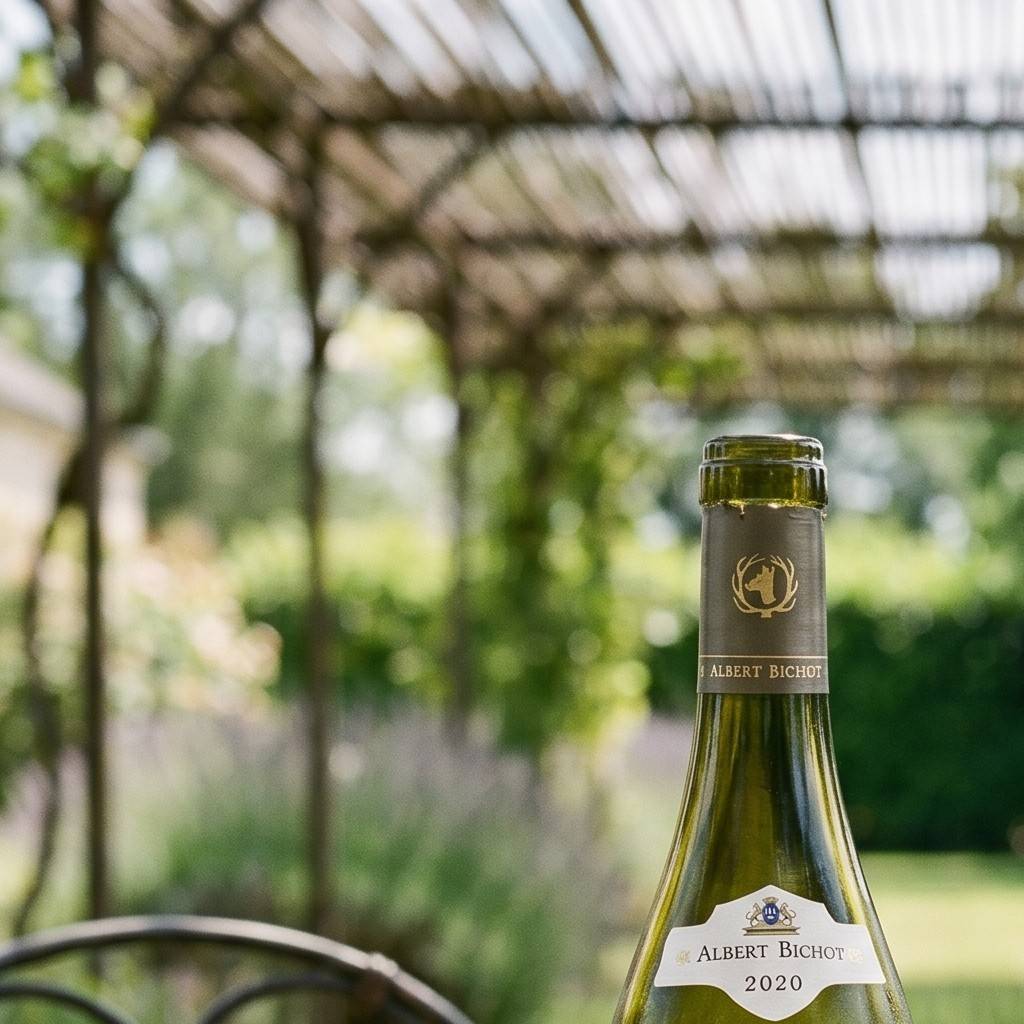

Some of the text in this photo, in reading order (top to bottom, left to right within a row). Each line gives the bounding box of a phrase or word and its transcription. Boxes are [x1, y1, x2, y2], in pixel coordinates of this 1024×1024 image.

[710, 664, 763, 678] ALBERT
[769, 664, 822, 678] BICHOT
[696, 940, 845, 963] ALBERT BICHOT
[744, 975, 803, 992] 2020
